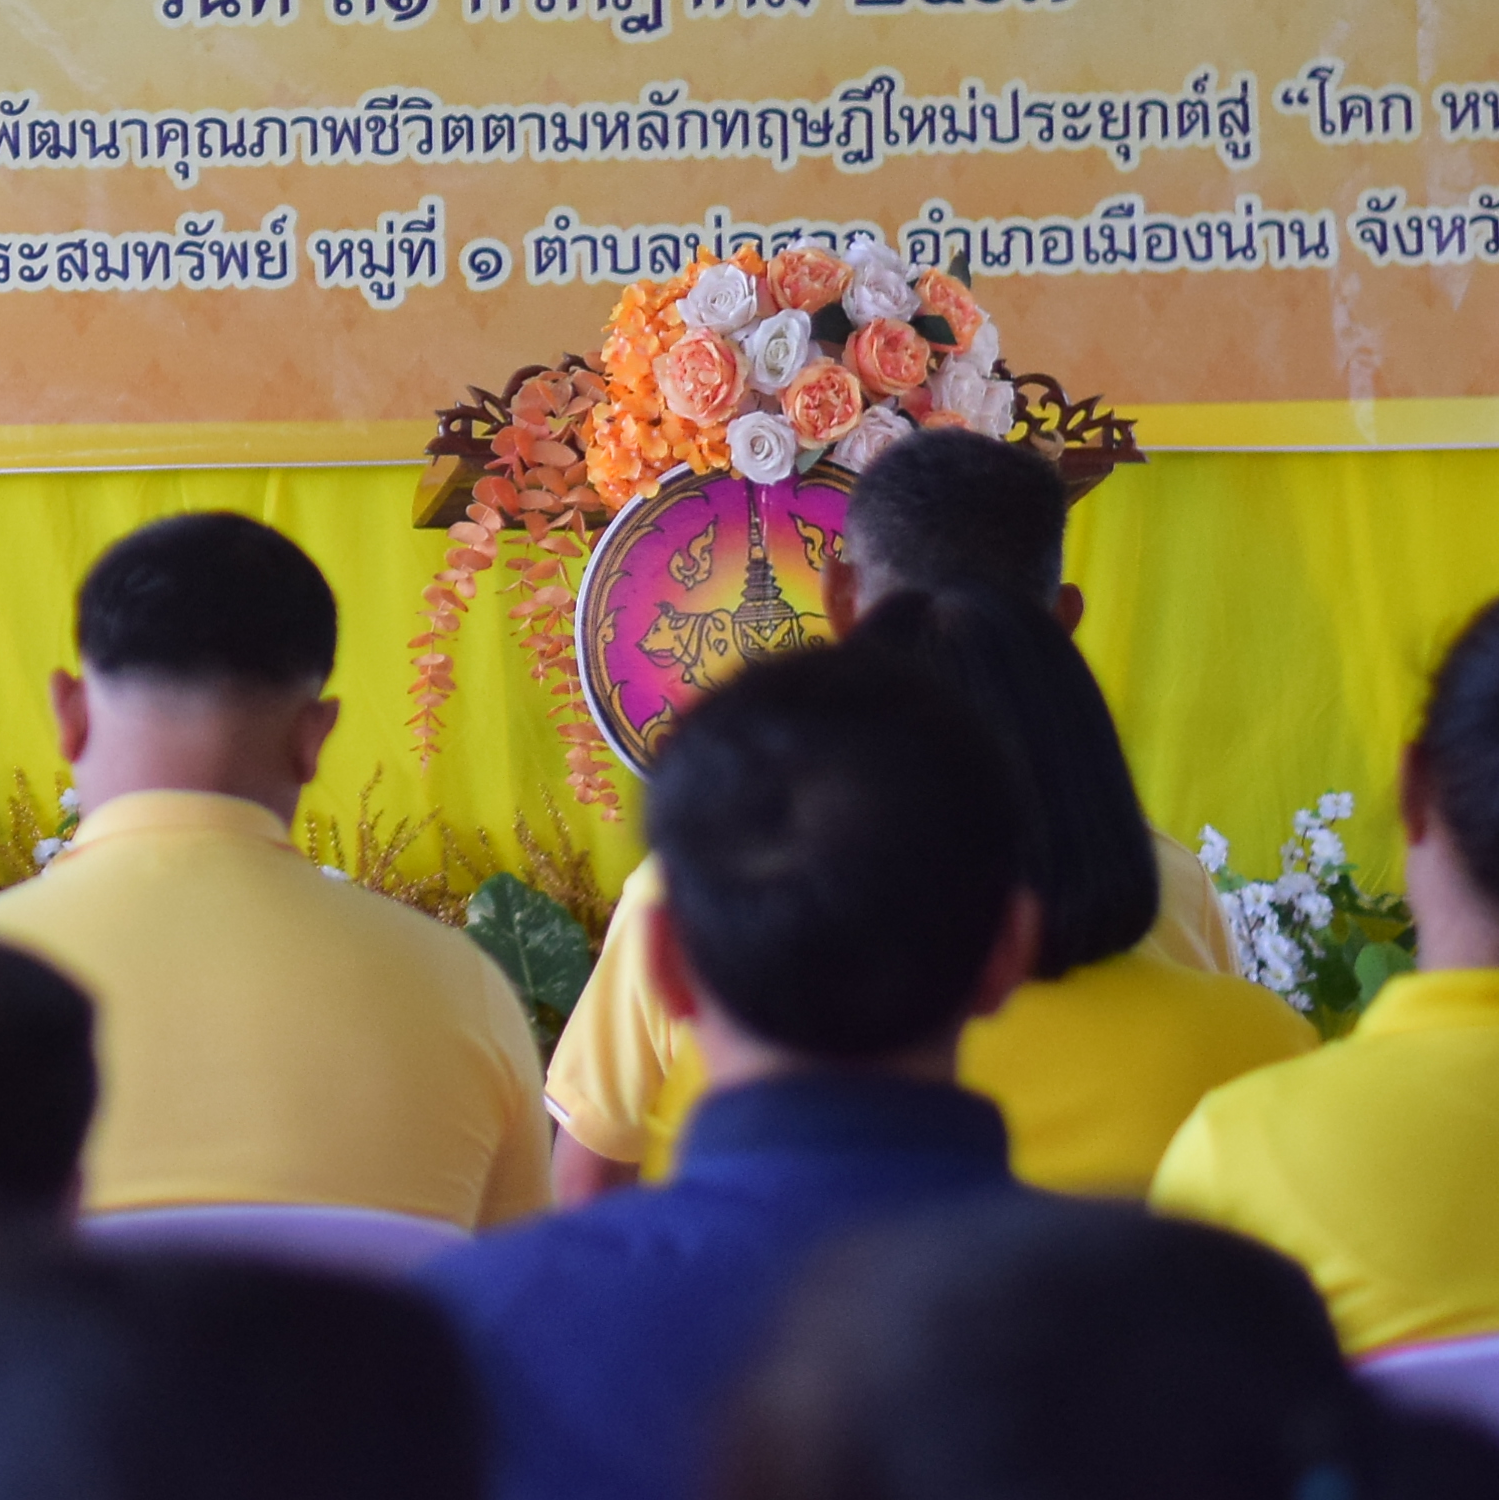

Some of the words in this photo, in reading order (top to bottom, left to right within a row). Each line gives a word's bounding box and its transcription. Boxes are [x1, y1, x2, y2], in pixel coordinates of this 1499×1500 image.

[315, 204, 437, 299] หมู่ที่
[468, 247, 503, 282] ๑
[906, 200, 1329, 267] อำเภอเมืองน่าน
